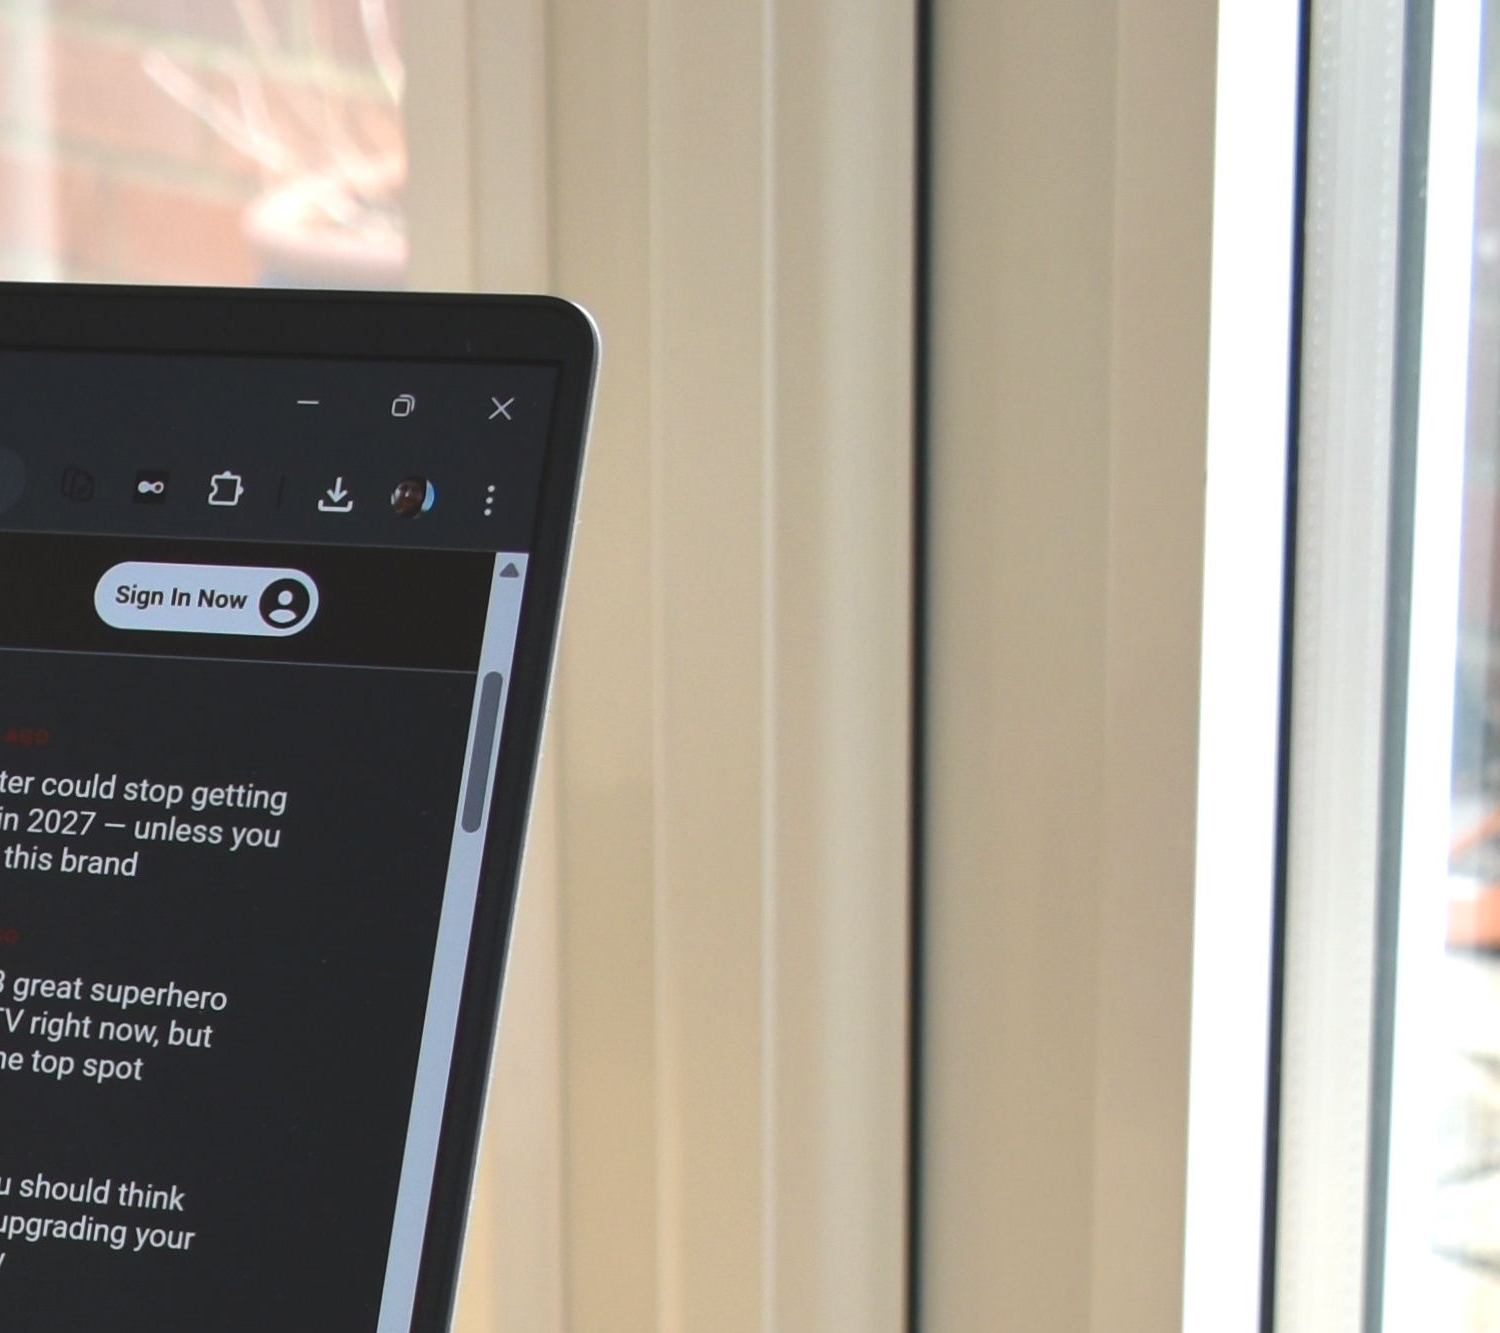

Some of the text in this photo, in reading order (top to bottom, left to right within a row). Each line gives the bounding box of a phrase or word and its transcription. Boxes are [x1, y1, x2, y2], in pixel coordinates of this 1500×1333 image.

[115, 584, 248, 610] Sign In Now
[41, 773, 117, 800] could
[123, 779, 184, 810] stop
[191, 783, 288, 817] getting
[26, 807, 97, 836] 2027
[134, 815, 223, 845] unless
[229, 826, 281, 852] you
[4, 843, 53, 871] this
[60, 846, 139, 877] brand
